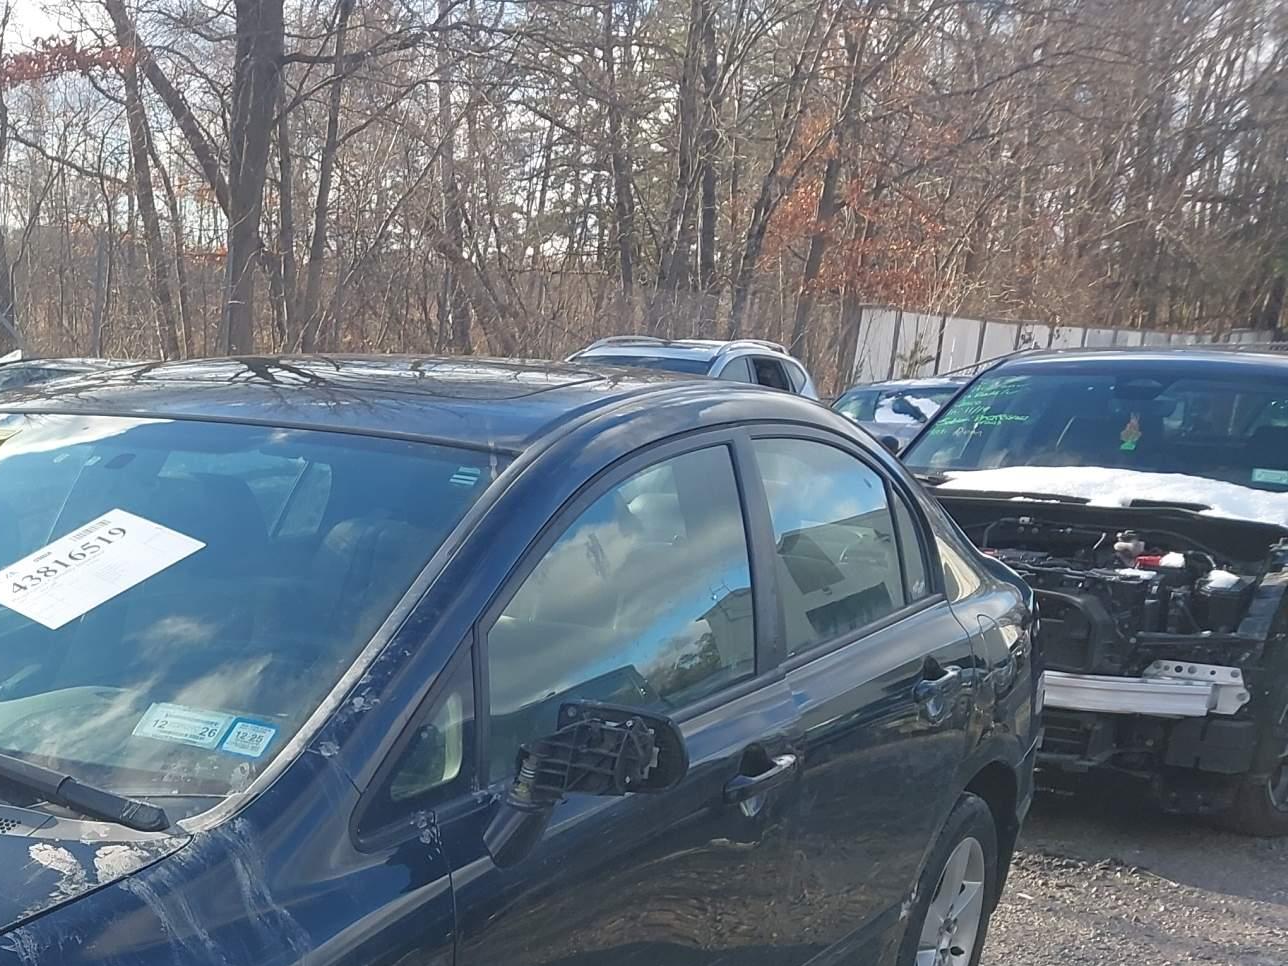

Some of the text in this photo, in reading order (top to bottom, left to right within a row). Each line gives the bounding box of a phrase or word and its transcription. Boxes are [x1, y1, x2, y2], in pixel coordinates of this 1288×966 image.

[12, 527, 127, 594] 43816519
[152, 719, 169, 729] 12
[199, 727, 218, 738] 26
